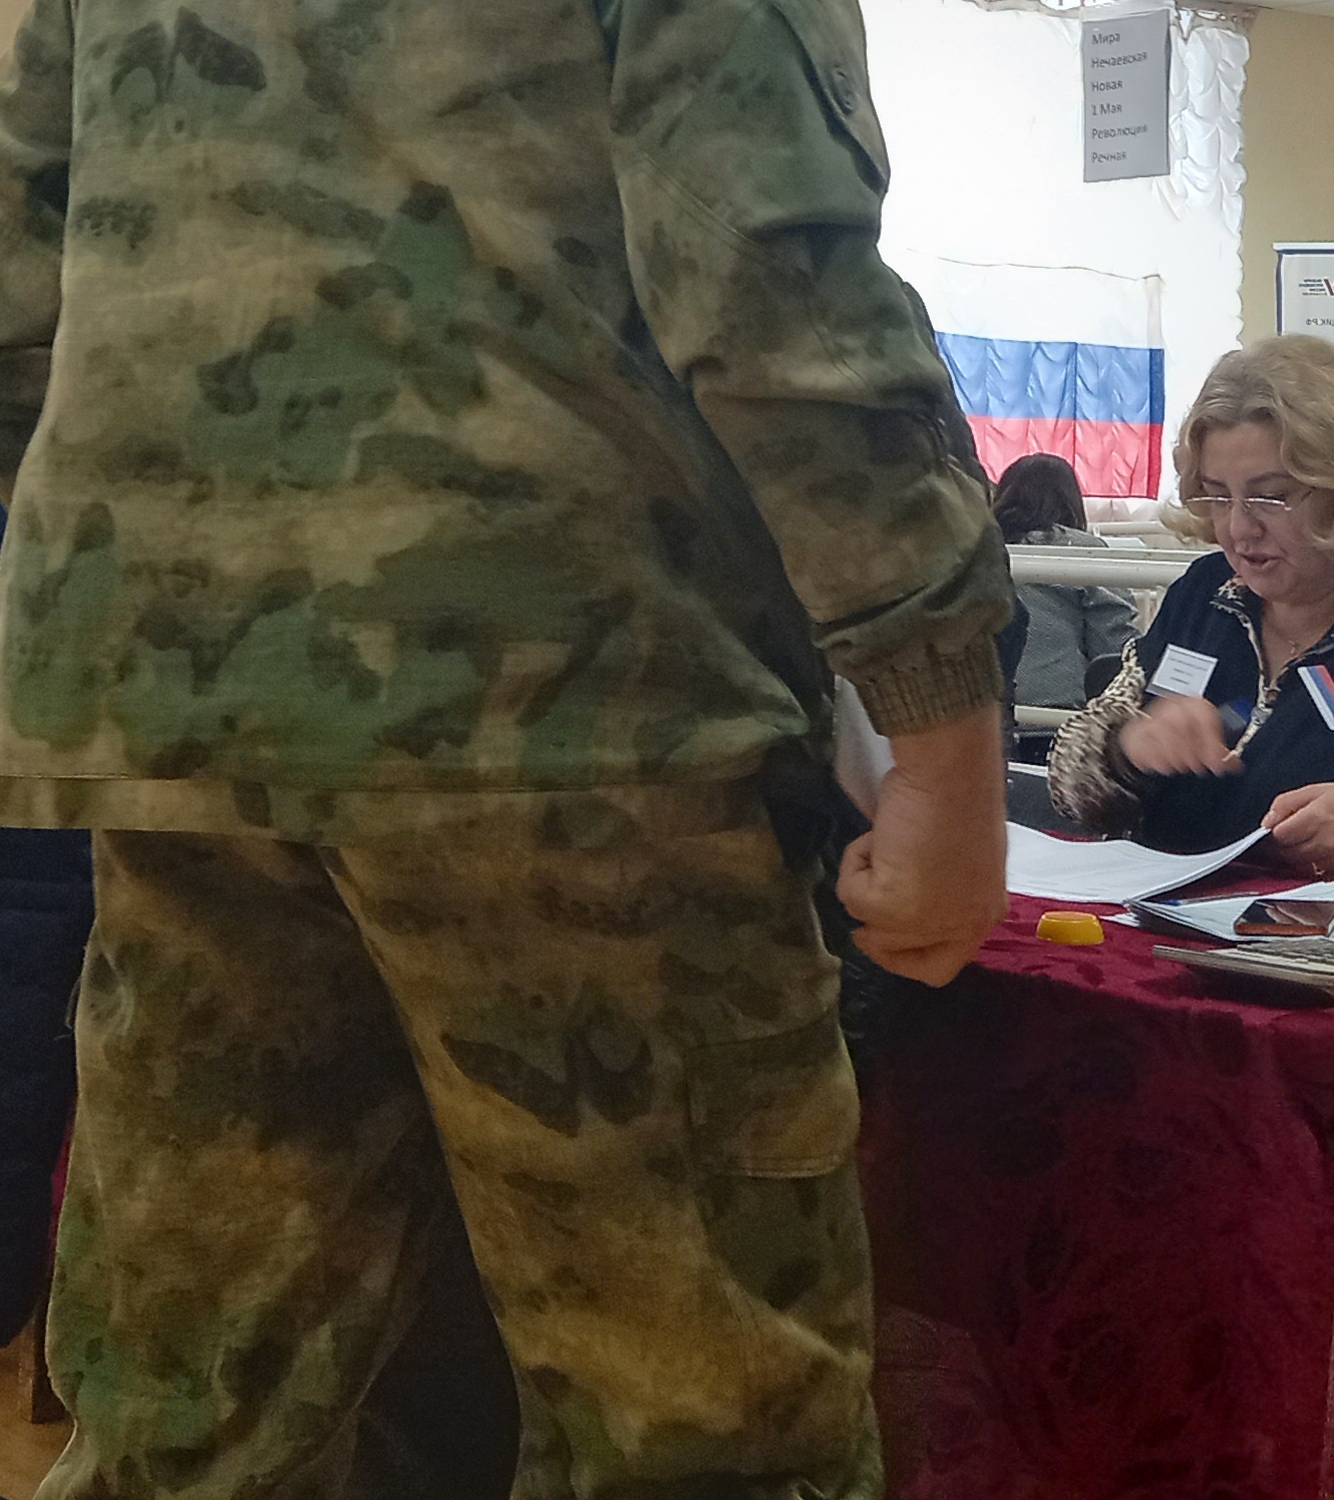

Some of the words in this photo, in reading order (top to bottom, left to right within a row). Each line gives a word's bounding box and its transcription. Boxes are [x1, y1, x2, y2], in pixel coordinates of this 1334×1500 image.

[1092, 33, 1121, 46] Мира
[1091, 81, 1123, 93] Новая
[1091, 105, 1097, 116] 1
[1101, 103, 1122, 115] Мая
[1091, 151, 1127, 164] Речная
